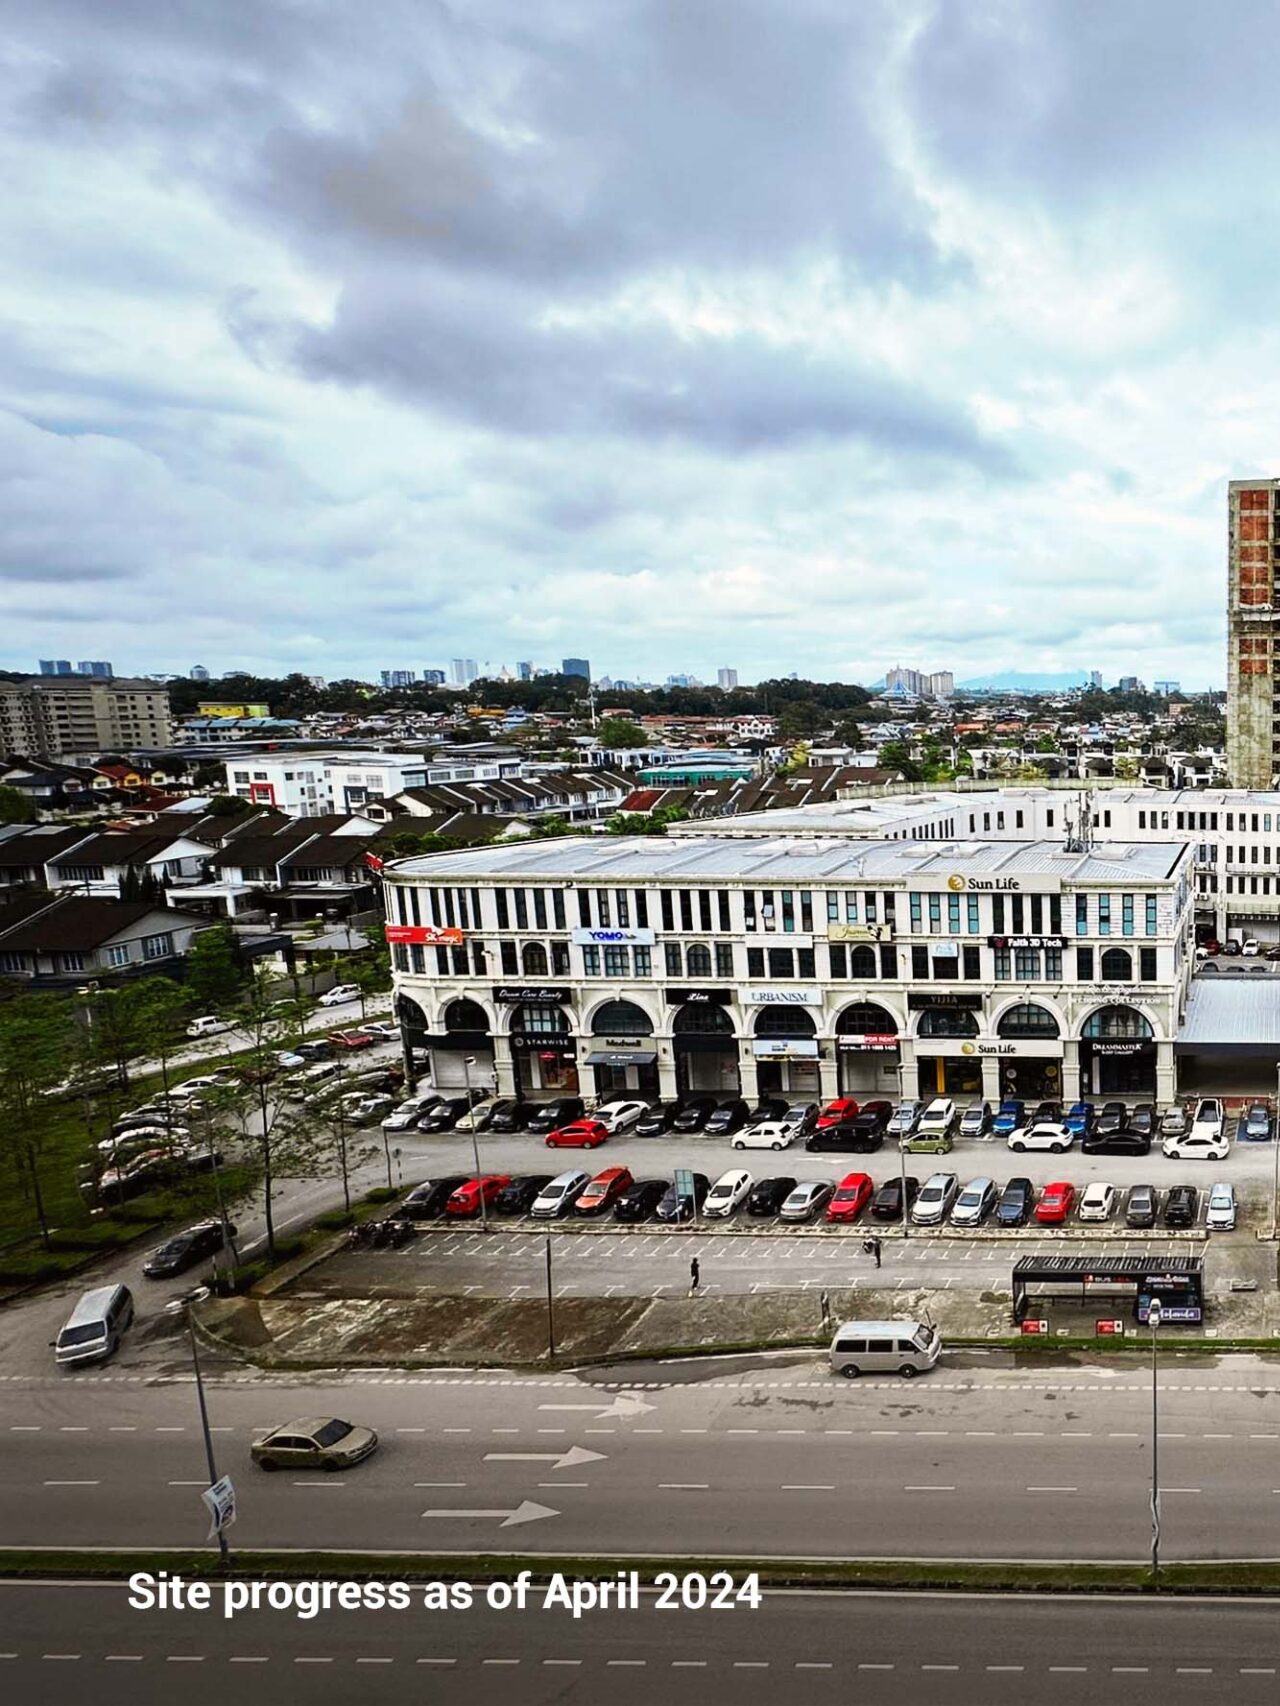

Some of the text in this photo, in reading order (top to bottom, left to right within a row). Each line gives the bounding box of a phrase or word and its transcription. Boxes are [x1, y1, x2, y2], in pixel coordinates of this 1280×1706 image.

[968, 878, 1020, 890] Sun Life
[588, 931, 624, 941] YOMO
[1007, 937, 1029, 948] Faith
[1041, 937, 1063, 948] Tech
[751, 992, 808, 1002] URBANISM
[526, 1038, 569, 1046] STARWISE
[977, 1044, 1017, 1054] Sun Life
